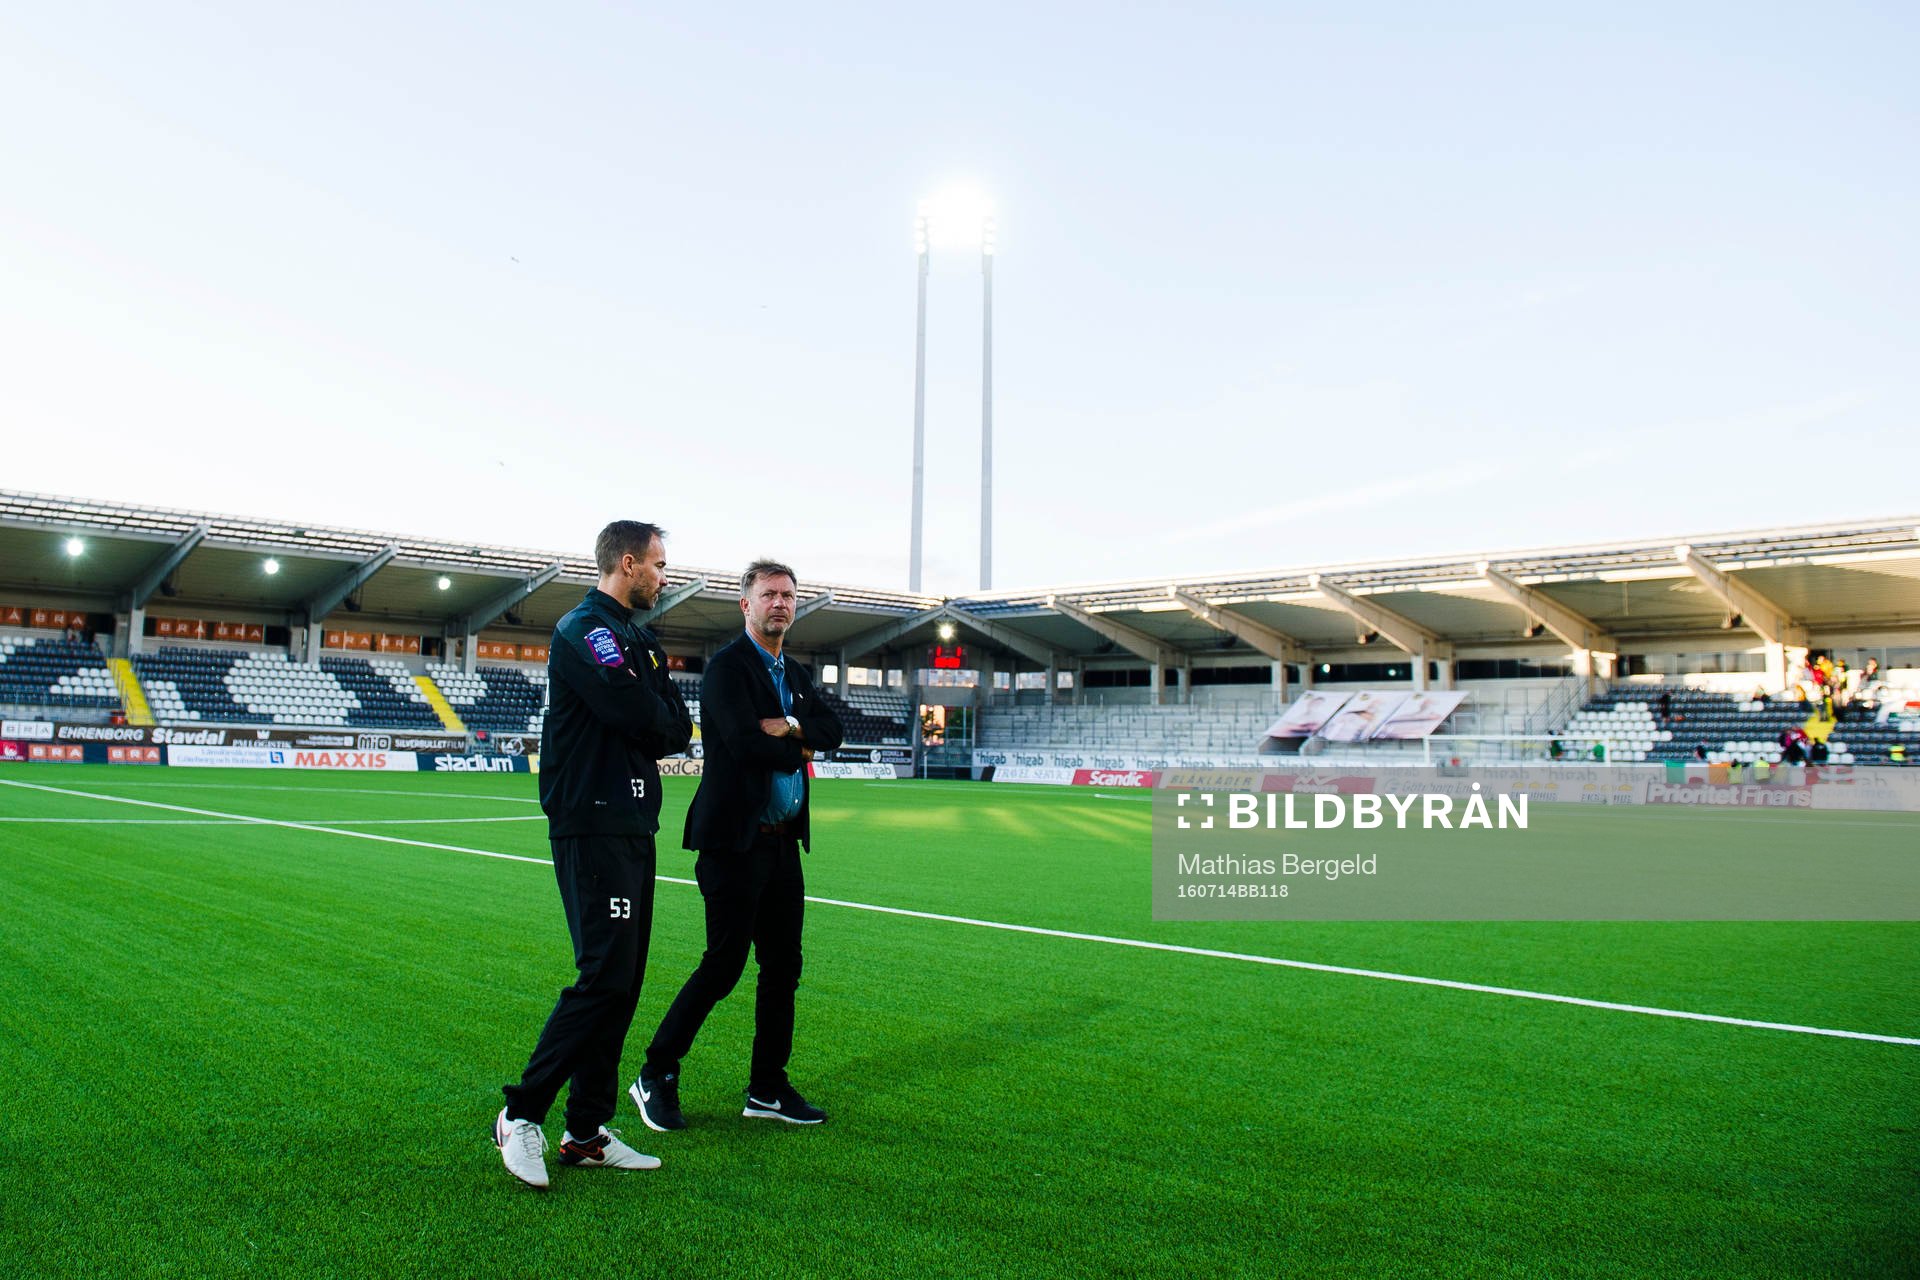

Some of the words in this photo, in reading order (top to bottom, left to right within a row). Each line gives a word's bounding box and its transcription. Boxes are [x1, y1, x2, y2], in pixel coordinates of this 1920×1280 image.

[480, 645, 515, 655] BRA
[58, 726, 144, 741] EHRENBORG
[151, 727, 226, 745] Stavdal
[32, 747, 81, 757] BRA
[111, 749, 158, 759] BRA
[295, 752, 386, 768] MAXXIS
[979, 751, 1007, 765] higab
[1016, 752, 1044, 766] higab
[1054, 753, 1084, 768] higab
[1094, 755, 1125, 769] higab
[434, 754, 514, 772] stadium
[822, 763, 852, 779] higab
[863, 764, 892, 779] higab
[1088, 771, 1143, 786] Scandic
[1649, 783, 1739, 806] Prioritet
[1741, 785, 1811, 807] Finans
[610, 898, 631, 919] 53
